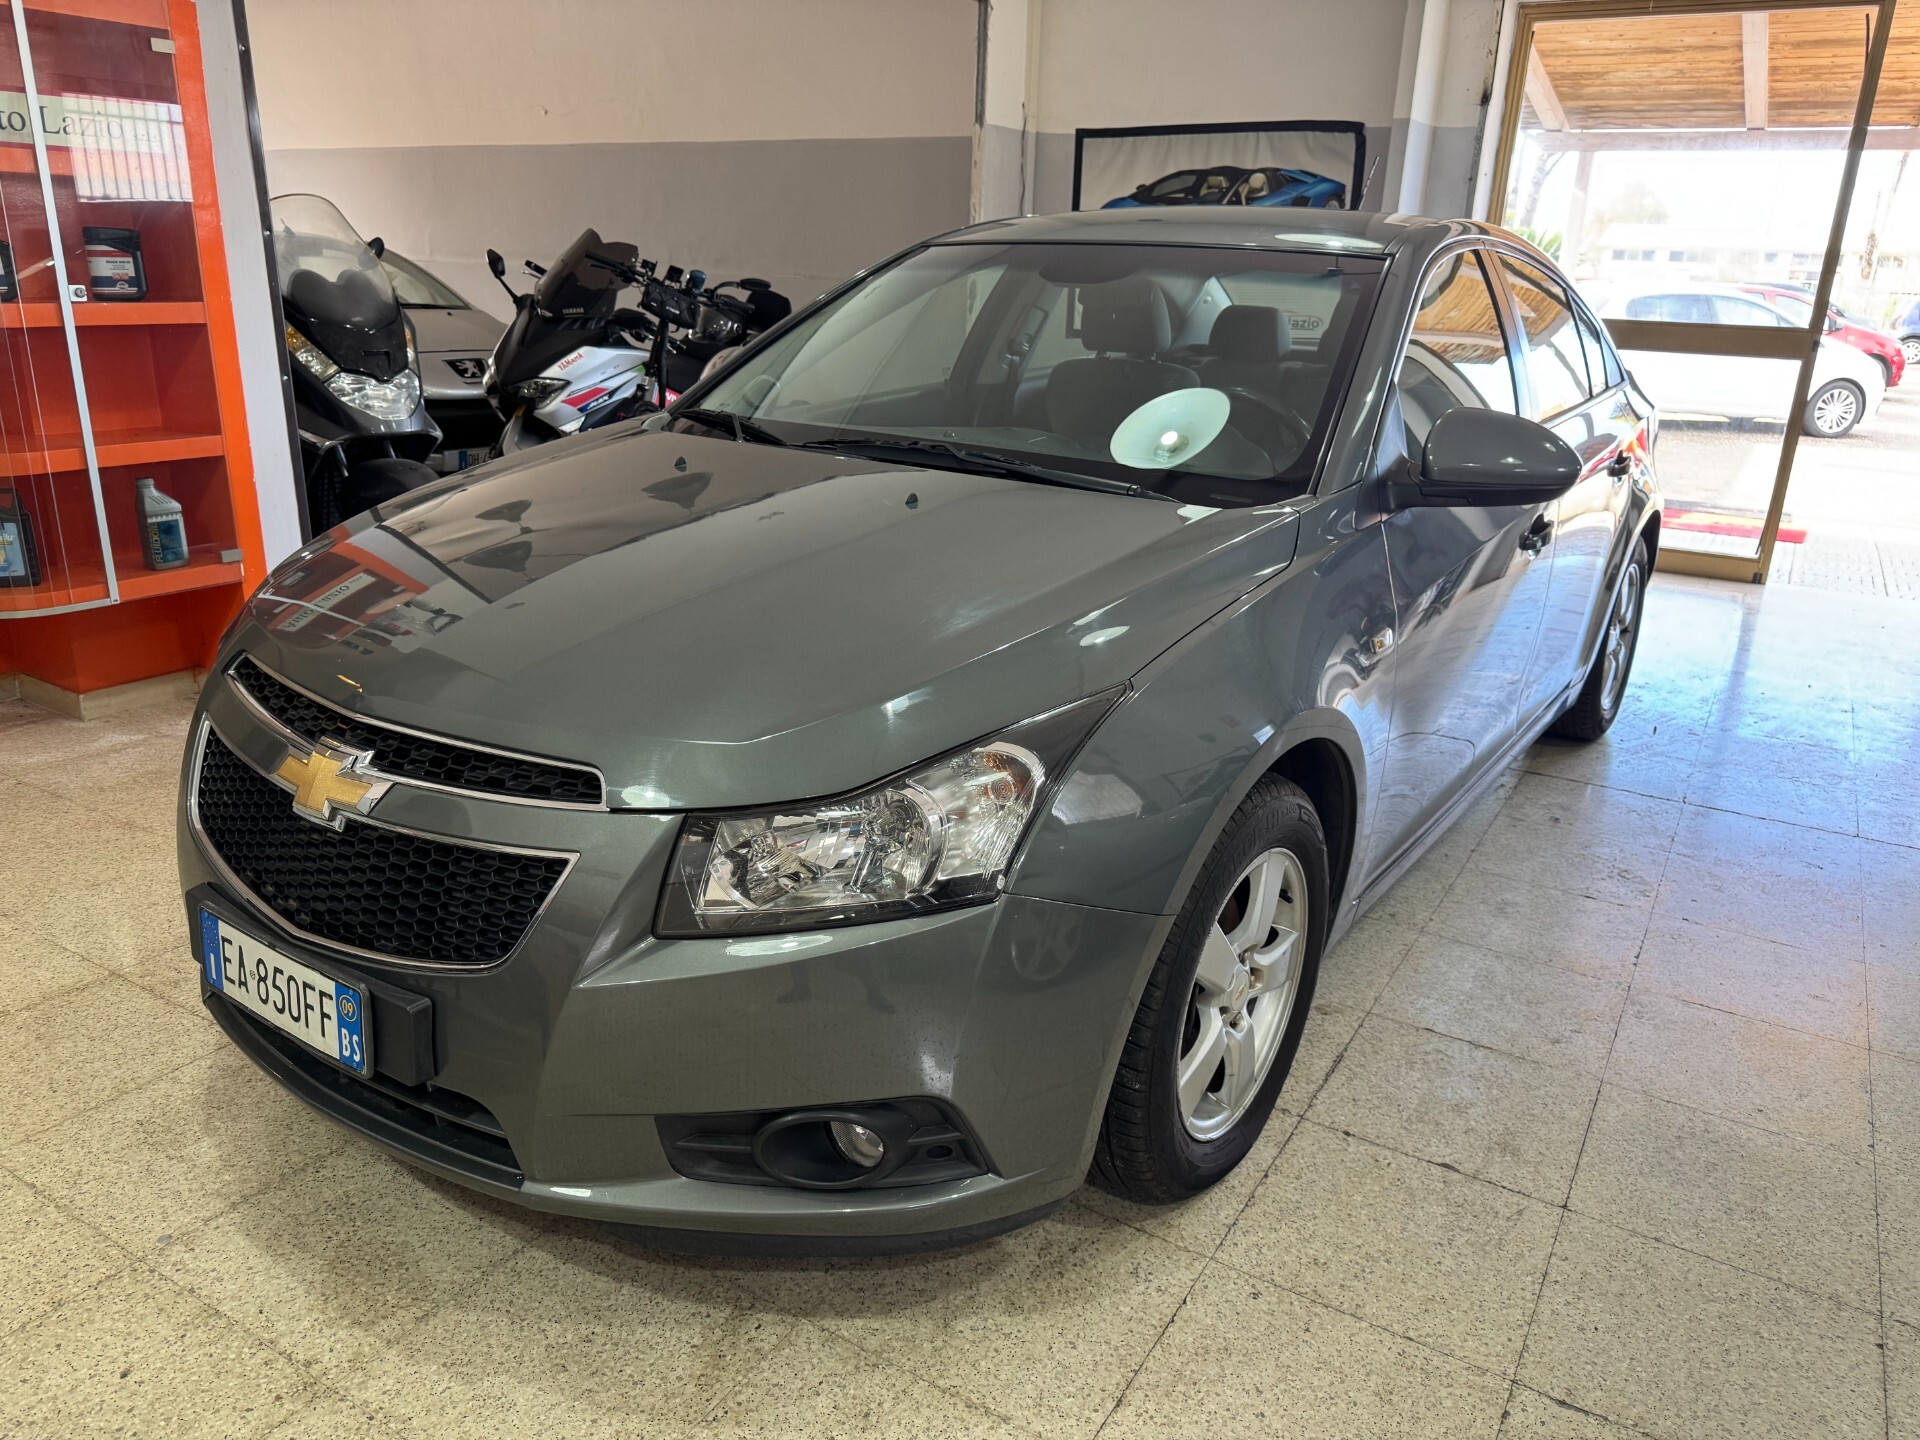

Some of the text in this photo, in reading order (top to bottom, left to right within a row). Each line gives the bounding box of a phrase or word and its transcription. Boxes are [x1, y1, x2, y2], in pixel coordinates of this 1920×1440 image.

[39, 105, 124, 140] Lazio
[342, 998, 353, 1017] 09
[341, 1027, 361, 1063] BS
